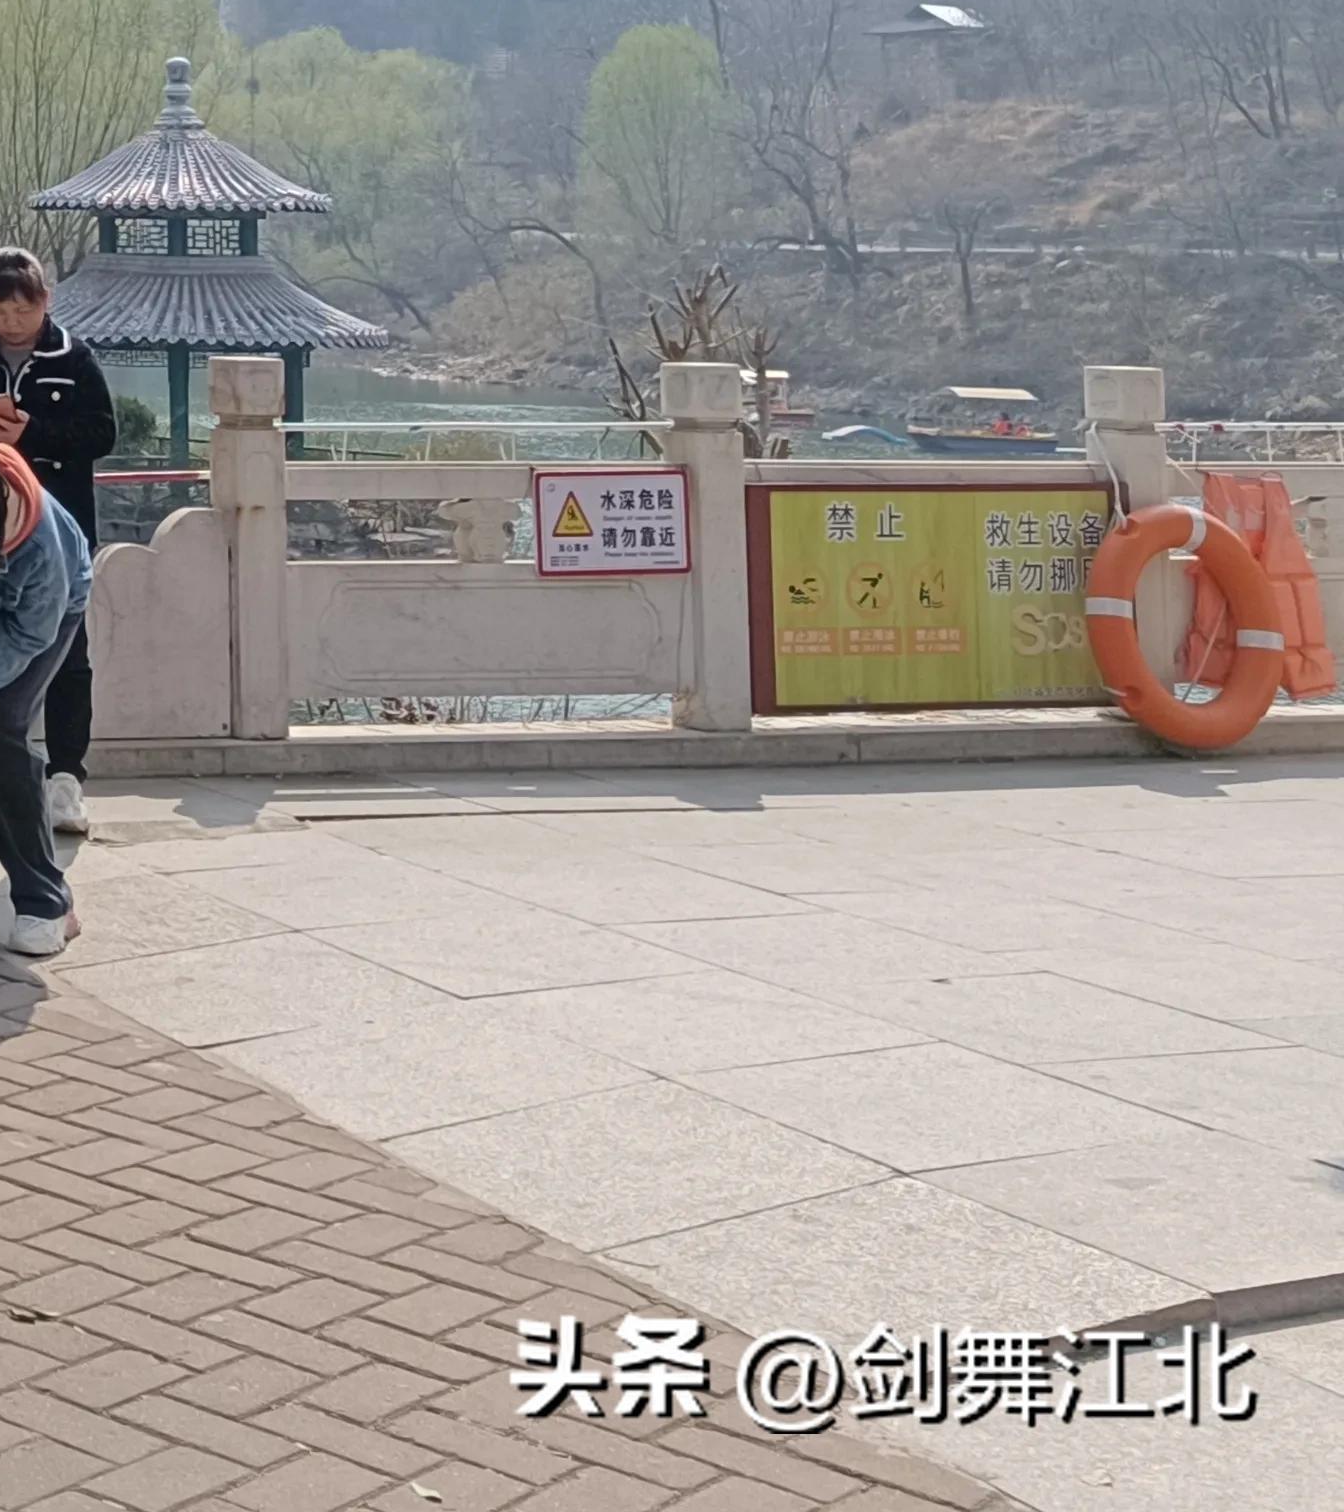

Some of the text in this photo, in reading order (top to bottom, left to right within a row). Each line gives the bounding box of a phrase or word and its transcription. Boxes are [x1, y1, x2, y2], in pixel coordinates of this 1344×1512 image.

[600, 488, 675, 511] 水深危险
[826, 503, 905, 541] 禁止
[985, 512, 1106, 548] 救生设备
[601, 526, 676, 549] 请勿靠近
